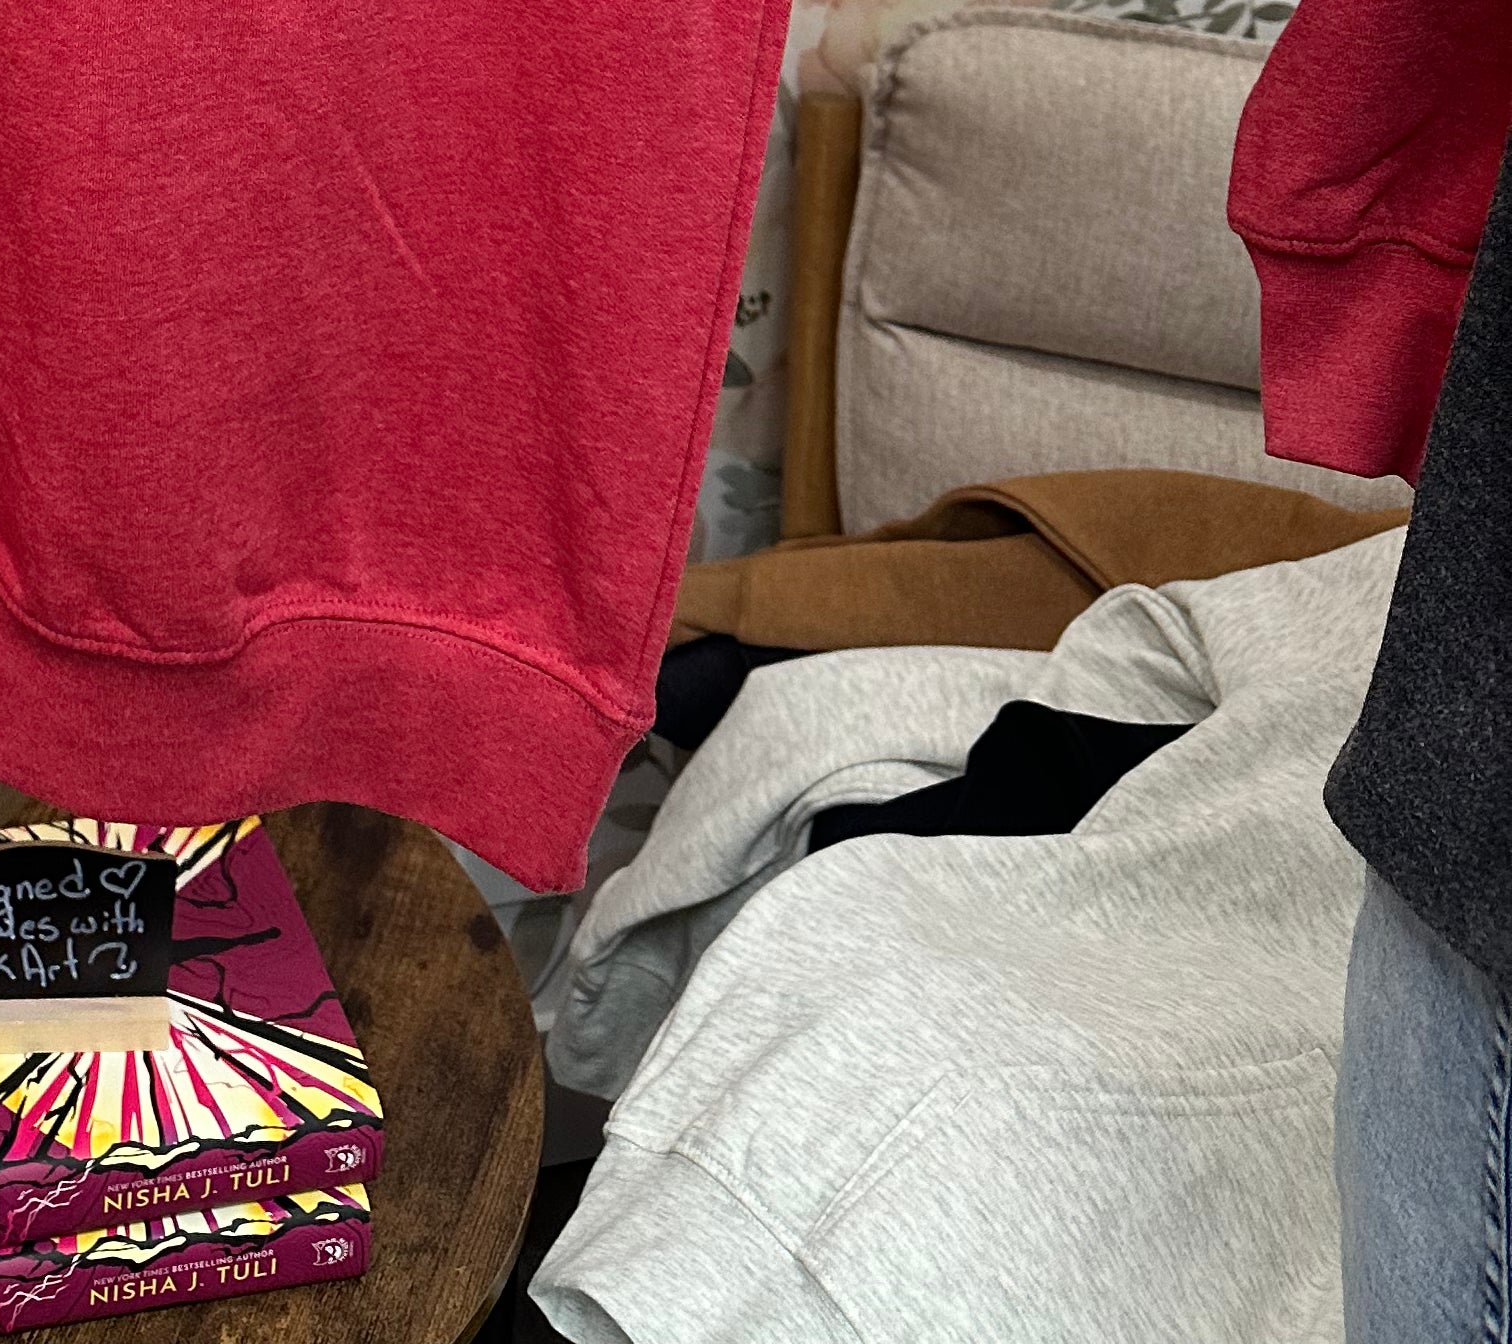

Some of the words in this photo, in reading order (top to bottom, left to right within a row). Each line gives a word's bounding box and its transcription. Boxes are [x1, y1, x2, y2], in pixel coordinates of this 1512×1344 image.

[70, 899, 144, 935] with
[20, 936, 79, 987] Art
[103, 1183, 191, 1213] NISHA
[201, 1178, 219, 1199] J.
[229, 1164, 291, 1192] TULI
[107, 1182, 129, 1193] NEW
[130, 1178, 155, 1189] YORK
[155, 1173, 184, 1184] TIMES
[185, 1163, 247, 1179] BESTSELLING
[248, 1155, 288, 1169] AUTHOR
[90, 1281, 178, 1307] NISHA
[187, 1272, 205, 1293] J.
[216, 1257, 278, 1285] TULI
[93, 1276, 114, 1287] NEW
[116, 1271, 141, 1283] YORK
[142, 1266, 170, 1278] TIMES
[171, 1255, 234, 1273] BESTSELLING
[236, 1248, 275, 1262] AUTHOR
